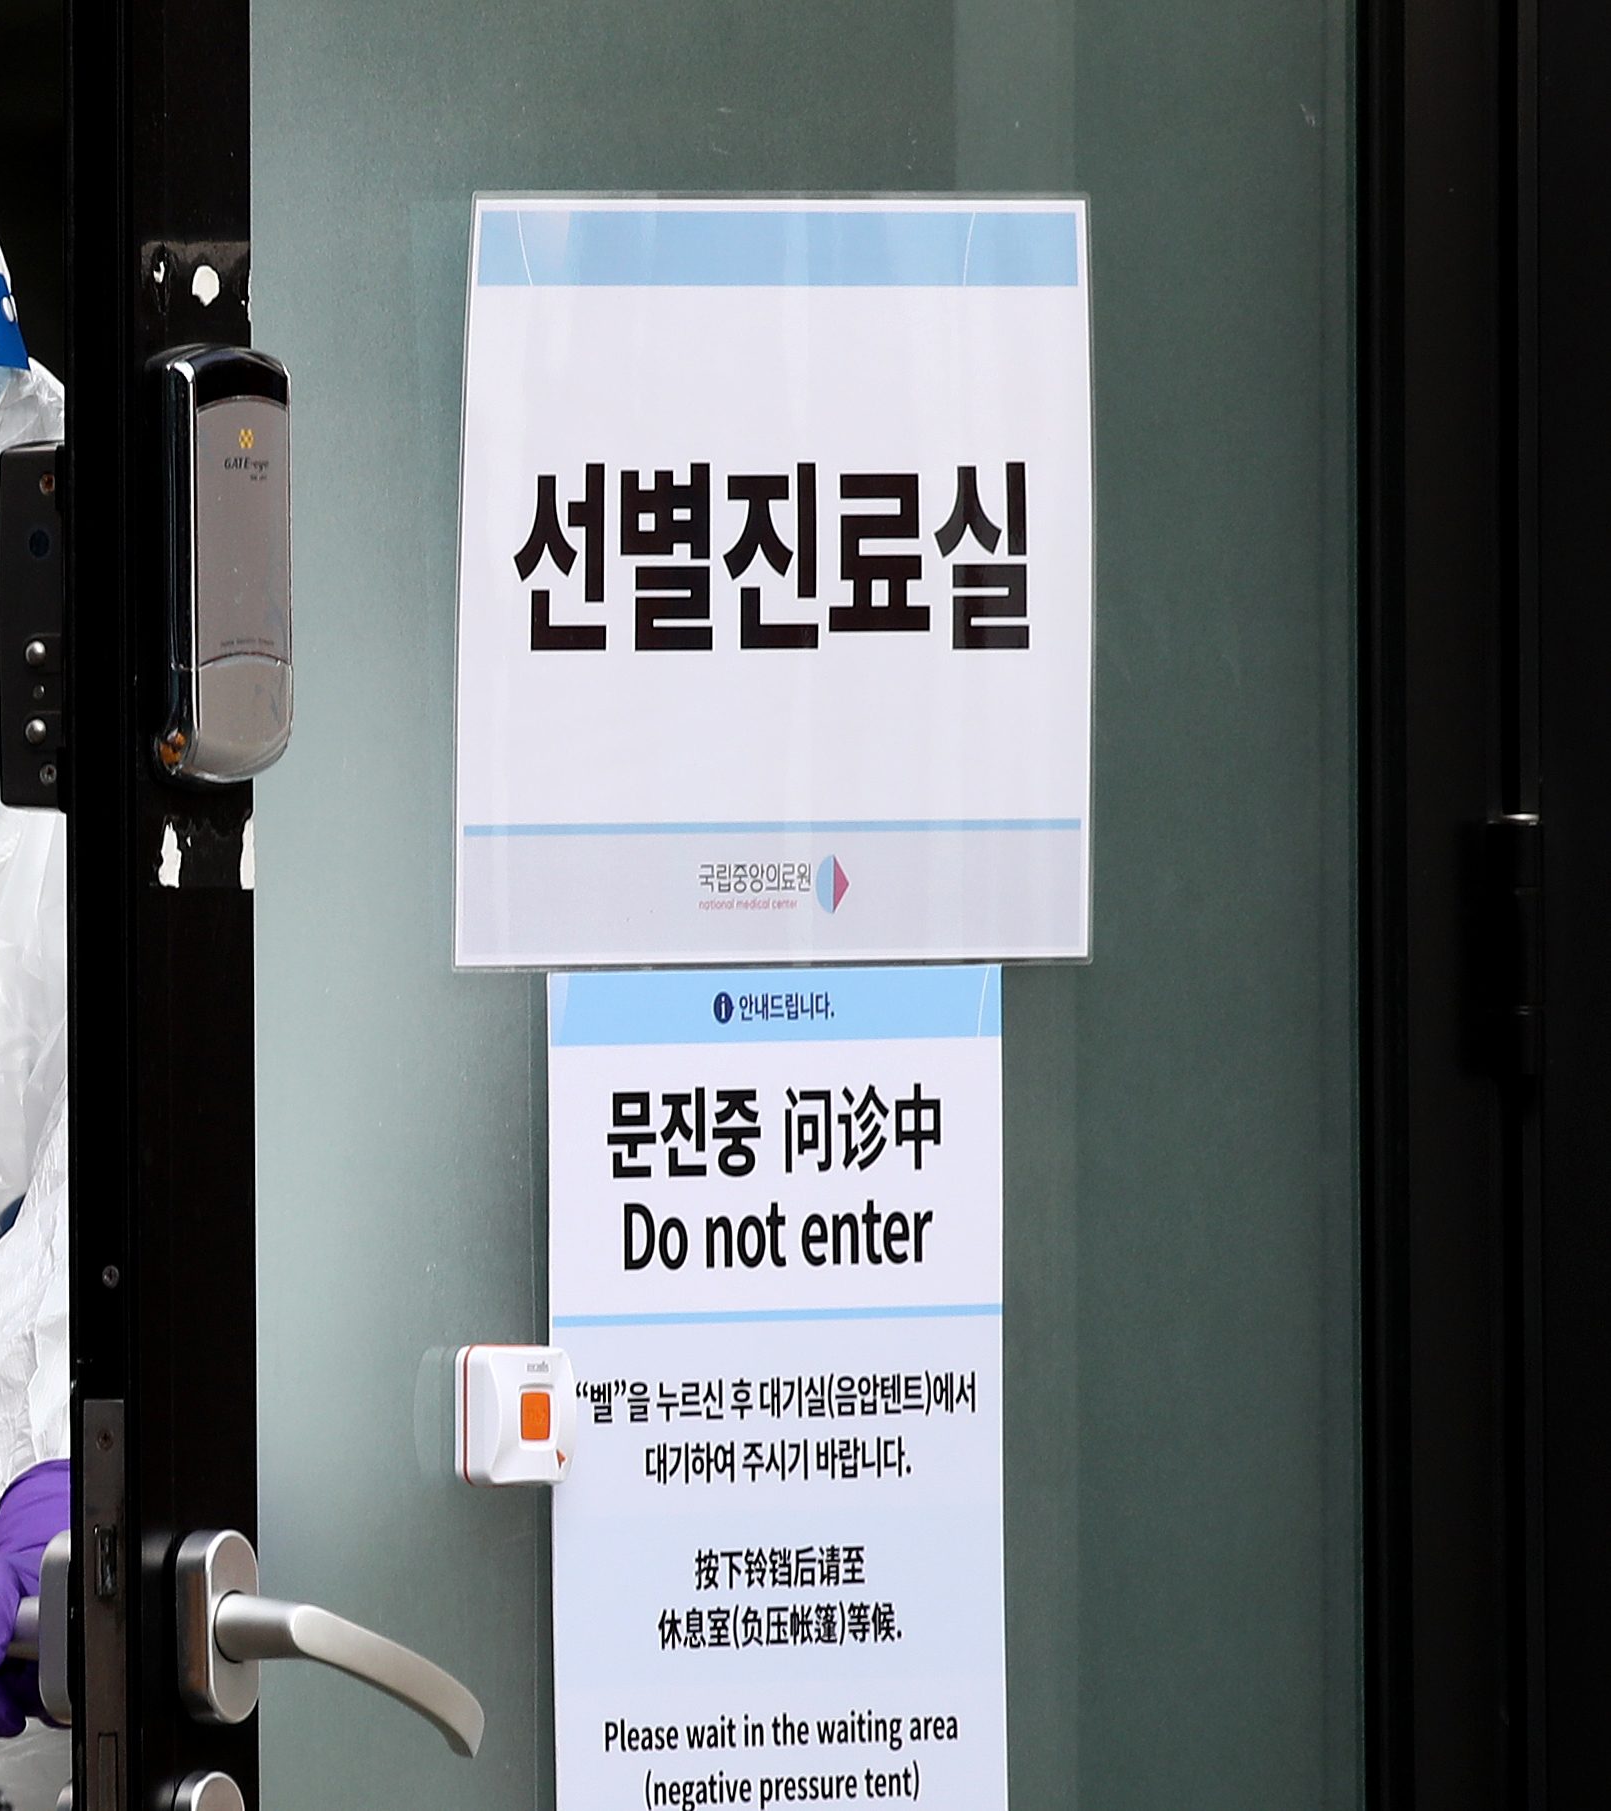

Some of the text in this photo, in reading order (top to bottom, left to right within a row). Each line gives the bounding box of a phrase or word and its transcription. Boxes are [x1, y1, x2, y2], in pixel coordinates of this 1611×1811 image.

[513, 461, 1030, 652] 선별진료실
[699, 863, 811, 893] 국립중앙의료원
[698, 898, 798, 911] national medical center
[738, 991, 835, 1021] 안내드립니다.
[607, 1083, 941, 1179] 문진중 问诊中
[623, 1199, 933, 1271] Do not enter
[656, 1378, 724, 1422] 누르신
[730, 1378, 753, 1420] 후
[759, 1370, 976, 1419] 대기실(음압텐트)에서
[645, 1436, 912, 1485] 대기하여 주시기 바랍니다.
[694, 1545, 865, 1591] 按下铃铛后请至
[605, 1709, 958, 1752] Please wait in the waiting area
[645, 1760, 920, 1811] (negative pressure tent)
